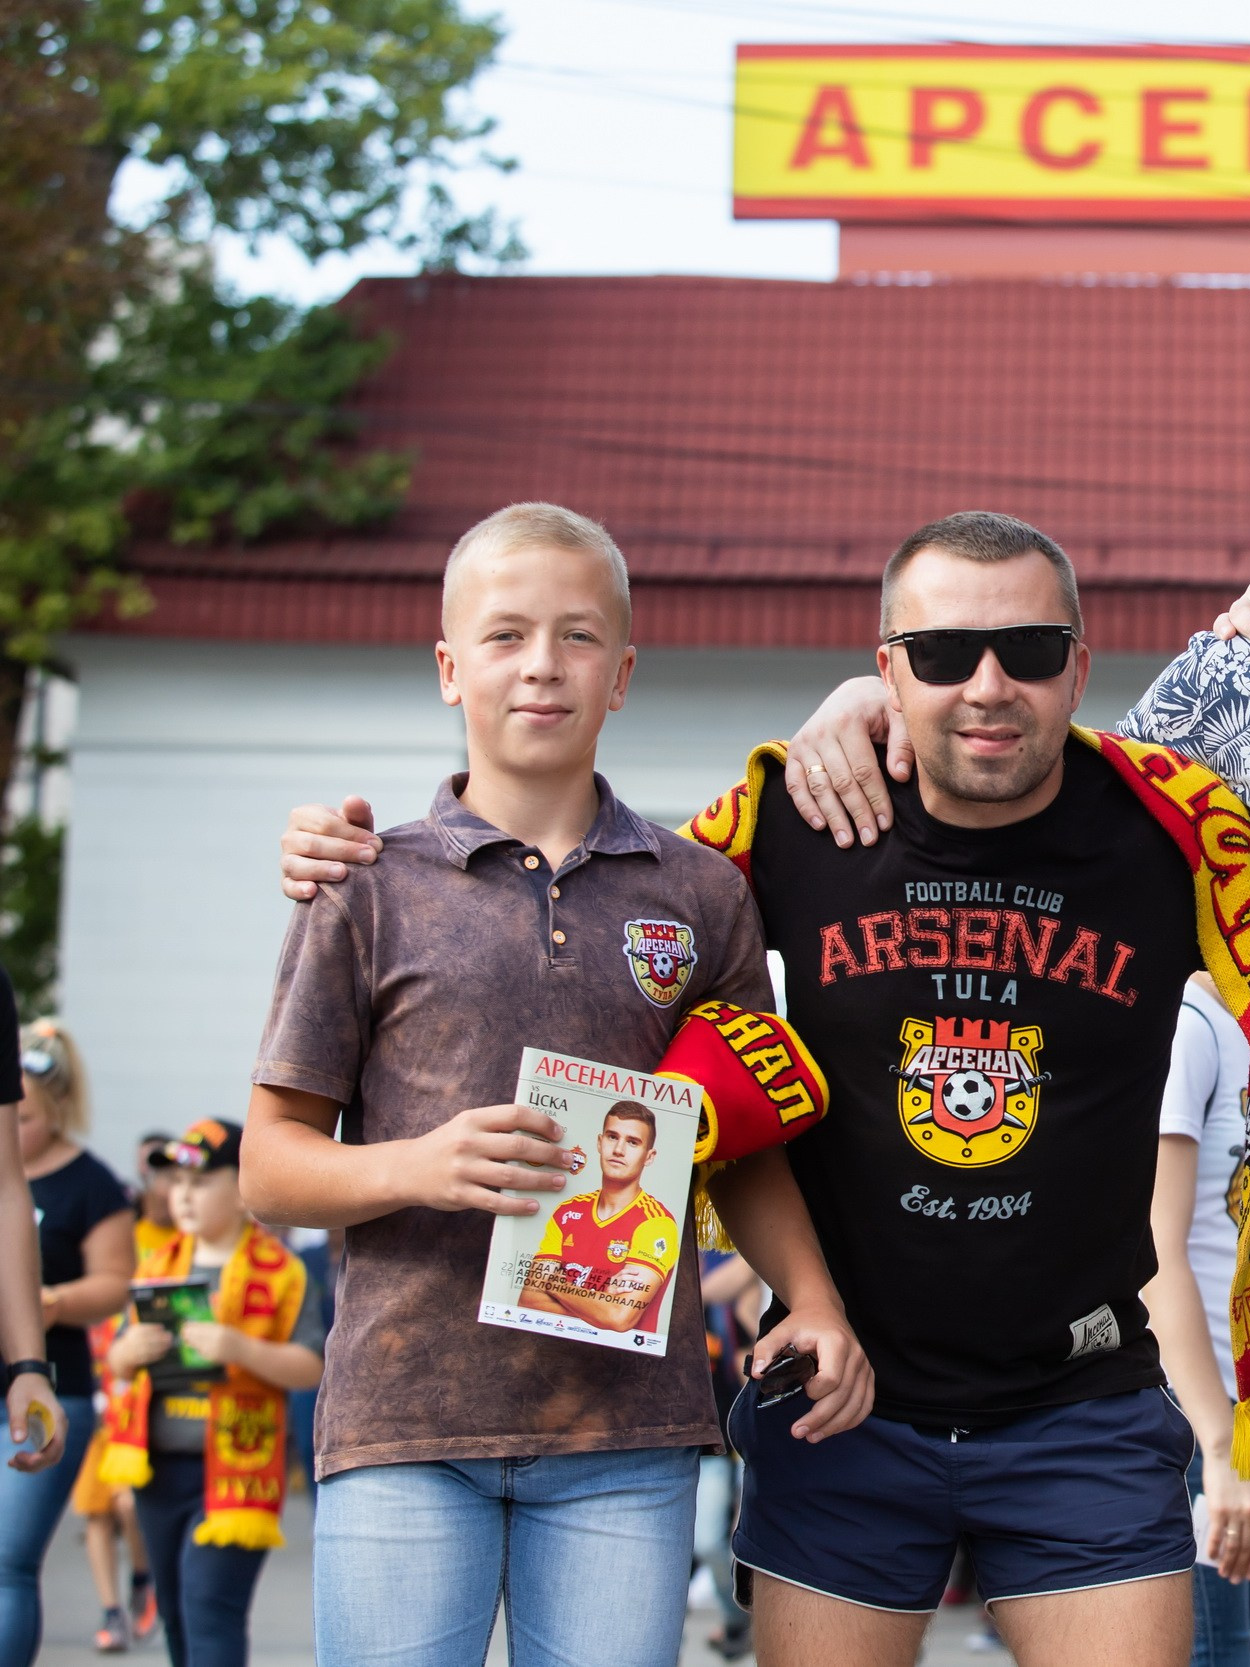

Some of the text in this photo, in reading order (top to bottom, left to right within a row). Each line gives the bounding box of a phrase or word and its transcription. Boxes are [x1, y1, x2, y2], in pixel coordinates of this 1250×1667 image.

[905, 881, 1065, 913] FOOTBALL CLUB
[635, 938, 689, 960] АРСЕНАЛ
[819, 907, 1139, 1008] ARSENAL
[653, 987, 673, 1000] ТУЛА
[931, 973, 1018, 1006] TULA
[905, 1045, 1036, 1081] АРСЕНАЛ
[529, 1091, 568, 1112] ЦСКА
[900, 1184, 1032, 1221] Est. 1984
[517, 1259, 550, 1273] КОГДА
[589, 1274, 603, 1284] НЕ
[599, 1293, 650, 1311] РОНАЛДУ
